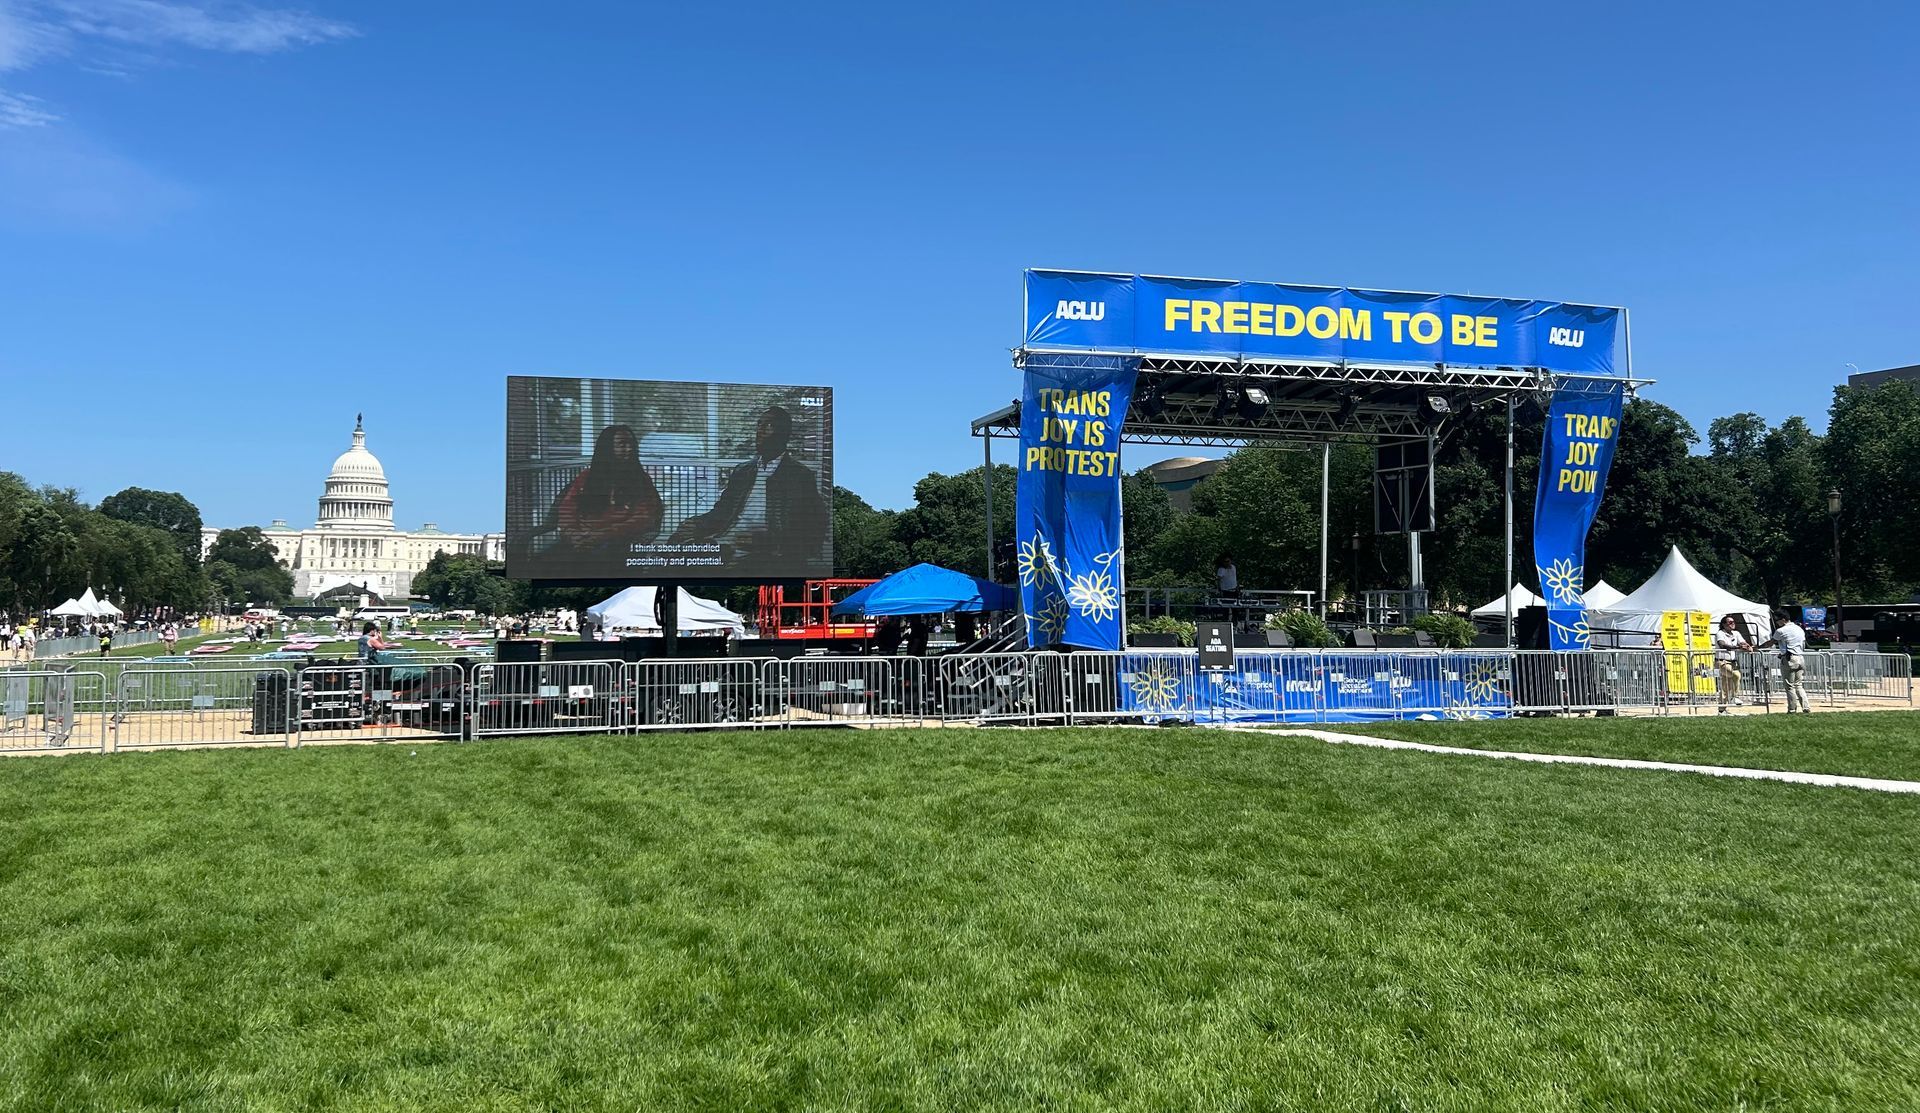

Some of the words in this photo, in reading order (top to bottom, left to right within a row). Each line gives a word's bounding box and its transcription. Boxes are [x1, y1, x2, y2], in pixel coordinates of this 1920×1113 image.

[1055, 300, 1104, 321] ACLU
[1165, 298, 1372, 341] FREEDOM
[1383, 311, 1443, 345] TO
[1451, 314, 1498, 348] BE
[1549, 326, 1585, 348] ACLU
[800, 397, 824, 407] ACLU
[1039, 388, 1111, 417] TRANS
[1040, 417, 1078, 445] JOY
[1084, 420, 1106, 447] IS
[1564, 413, 1618, 440] TRANS
[1026, 446, 1119, 477] PROTEST
[1565, 441, 1599, 466] JOY
[635, 543, 656, 552] think
[657, 543, 681, 552] about
[682, 543, 721, 552] unbridled
[626, 556, 669, 567] possibility
[669, 556, 685, 566] and
[1205, 644, 1228, 652] SEATING
